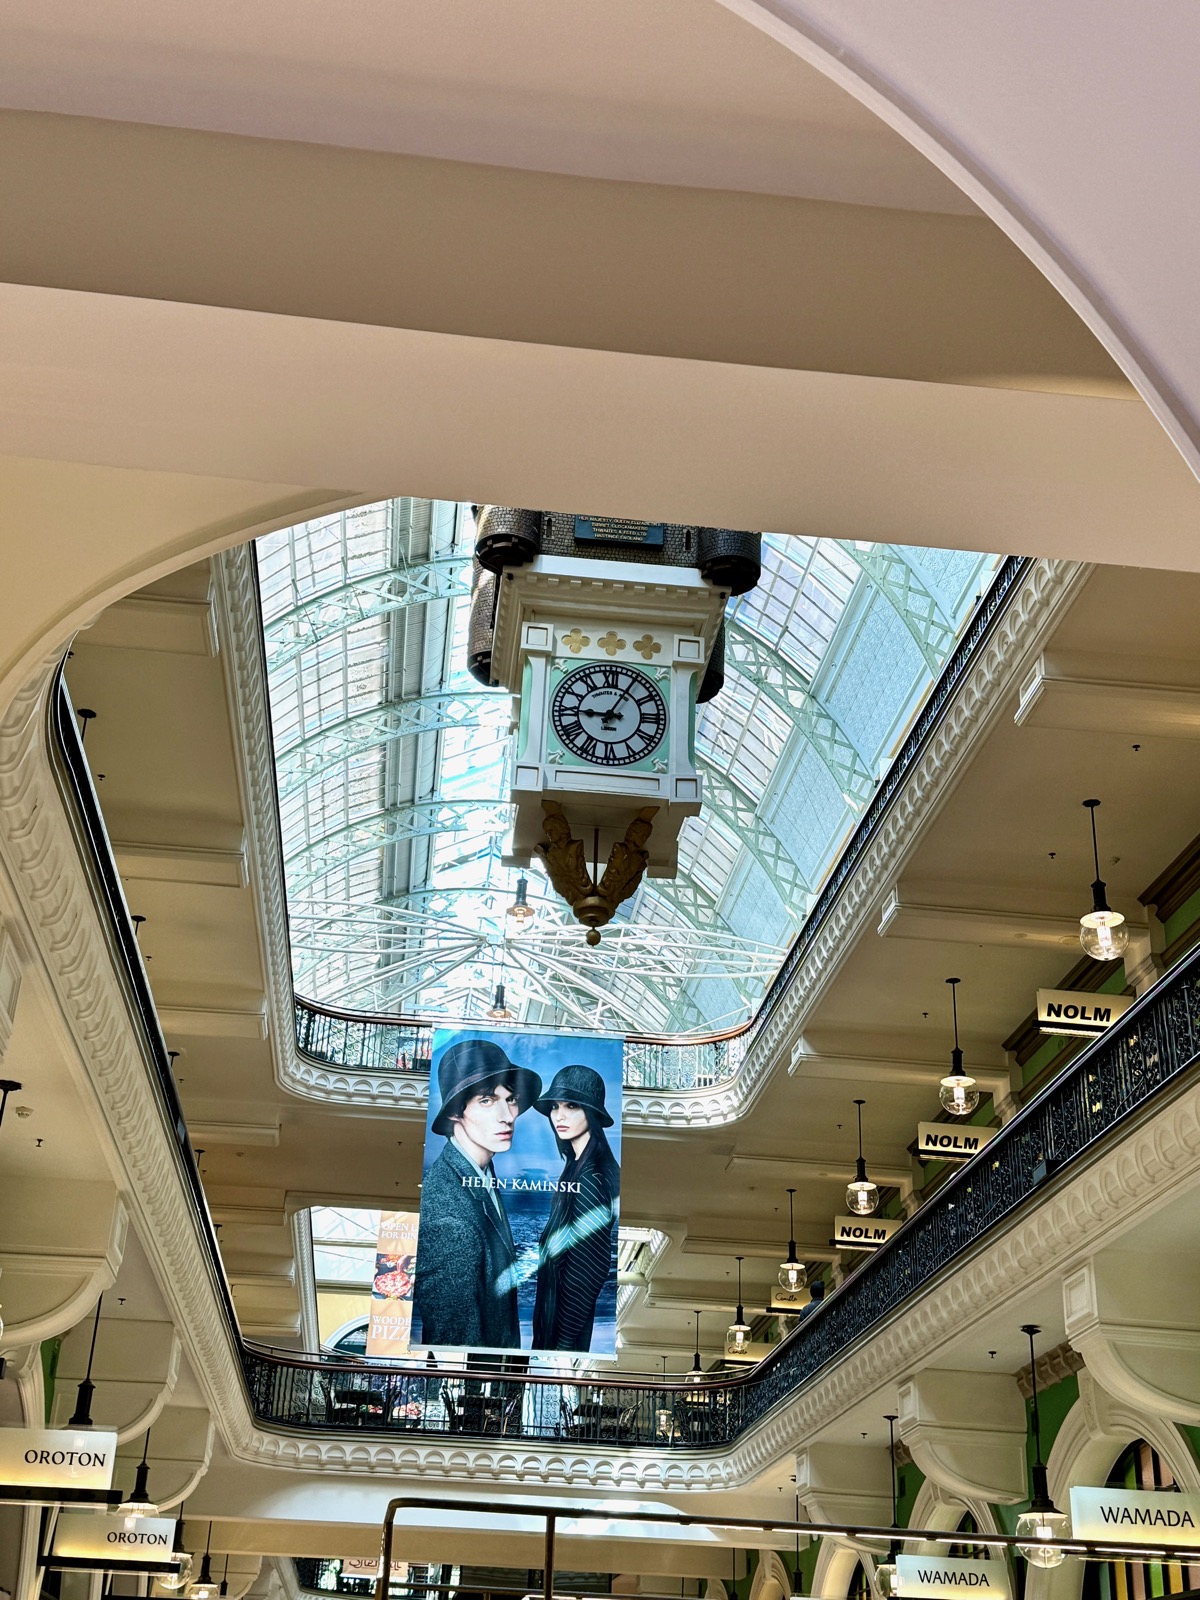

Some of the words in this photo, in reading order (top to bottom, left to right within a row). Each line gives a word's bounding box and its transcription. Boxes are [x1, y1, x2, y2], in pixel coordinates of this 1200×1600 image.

[1047, 1002, 1112, 1022] NOLM
[925, 1133, 979, 1150] NOLM
[461, 1176, 507, 1190] HELEN
[512, 1179, 581, 1194] KAMINSKI
[381, 1230, 399, 1239] FOR
[840, 1226, 887, 1240] NOLM
[24, 1449, 106, 1467] OROTON
[1100, 1505, 1196, 1528] WAMADA
[106, 1531, 168, 1545] OROTON
[917, 1569, 990, 1587] WAMADA
